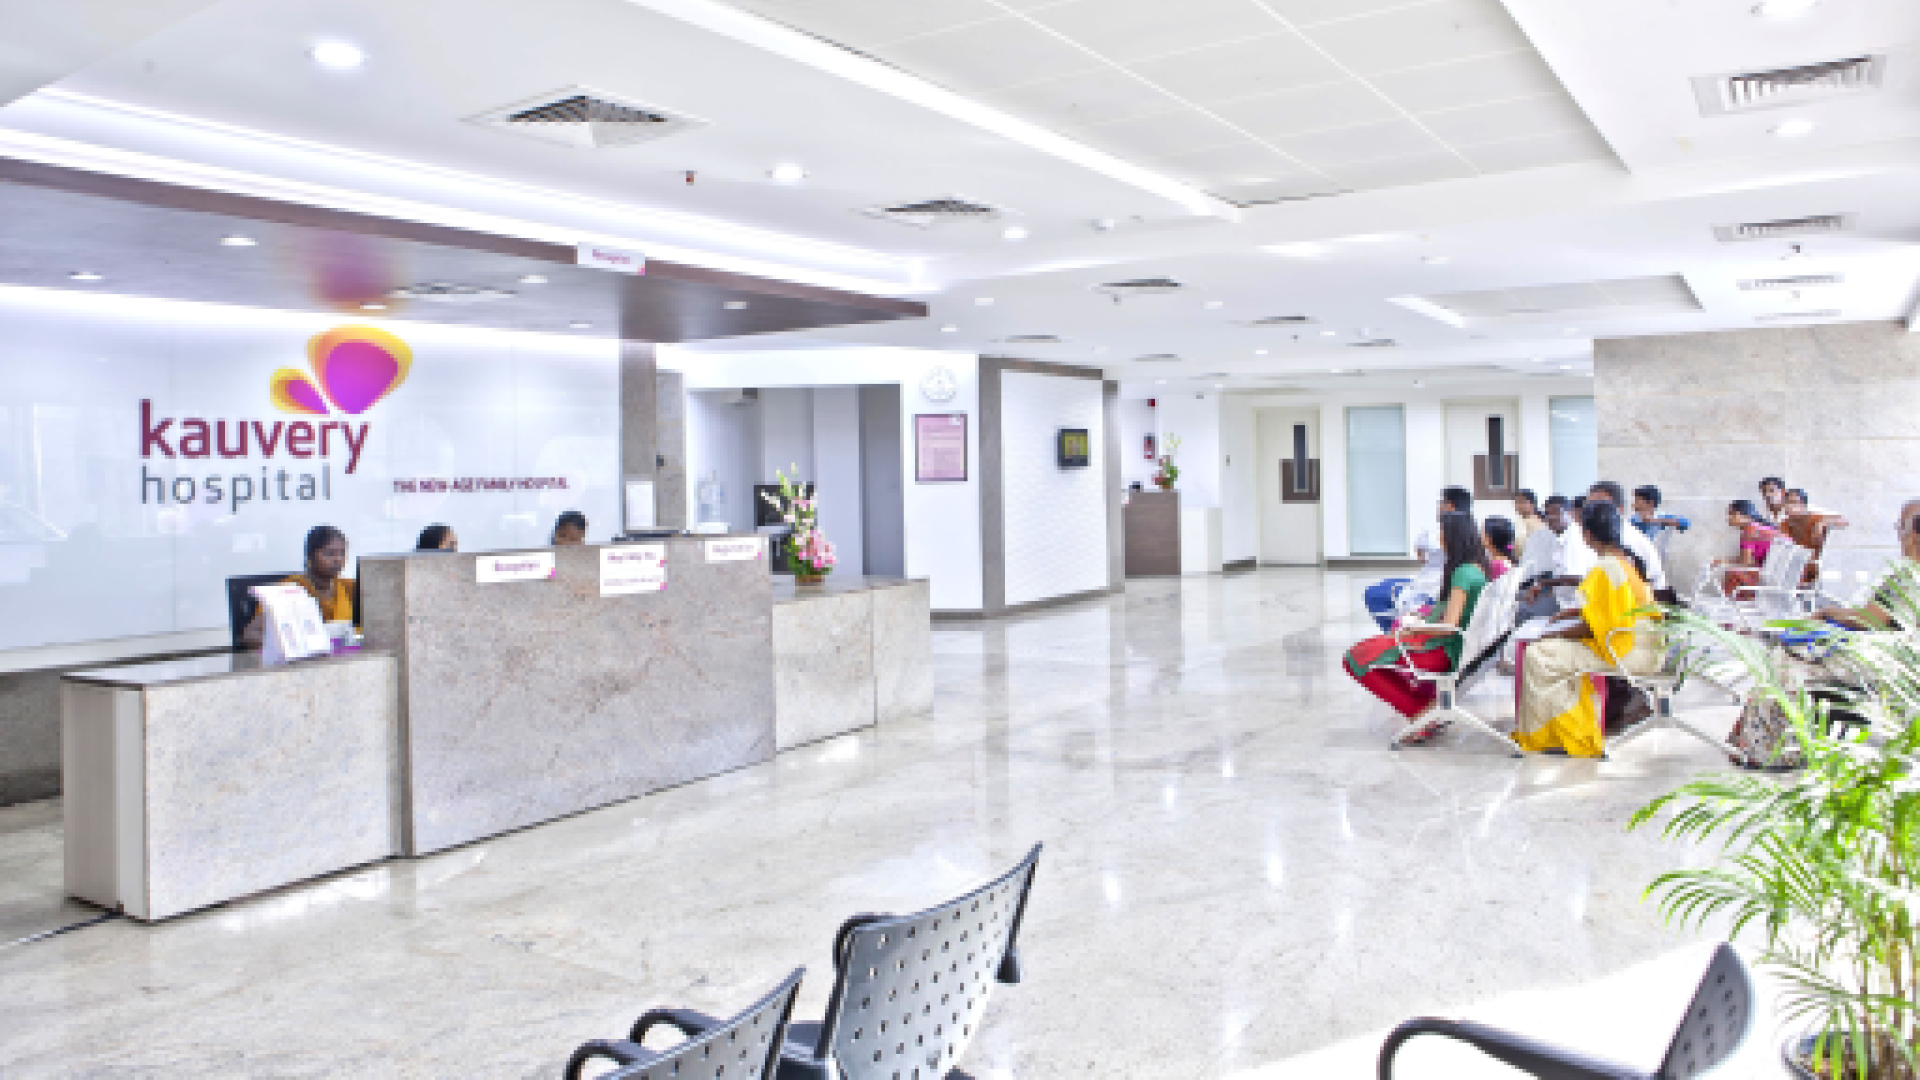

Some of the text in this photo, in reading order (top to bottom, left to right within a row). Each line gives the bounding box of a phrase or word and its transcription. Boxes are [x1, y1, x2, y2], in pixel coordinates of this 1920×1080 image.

[139, 398, 369, 474] kauvery
[141, 463, 332, 513] hospital
[393, 478, 416, 493] THE
[516, 477, 570, 490] HOSPITAL
